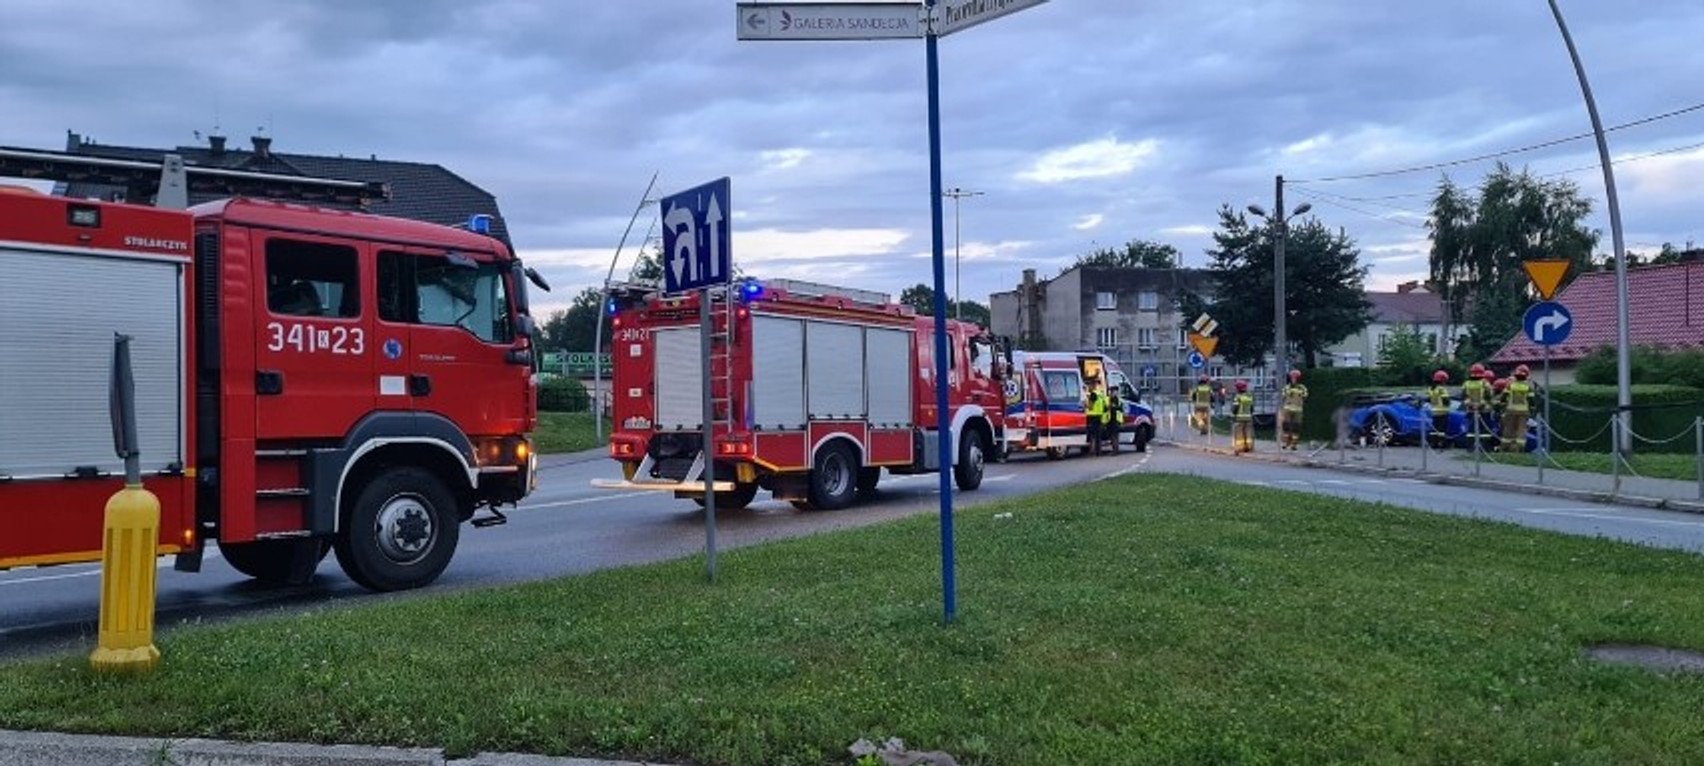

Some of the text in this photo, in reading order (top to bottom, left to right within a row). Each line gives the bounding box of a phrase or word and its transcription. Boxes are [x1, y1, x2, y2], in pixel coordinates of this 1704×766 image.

[794, 18, 909, 30] GALERIA SANDECJA
[124, 236, 188, 250] STOLARCZYK
